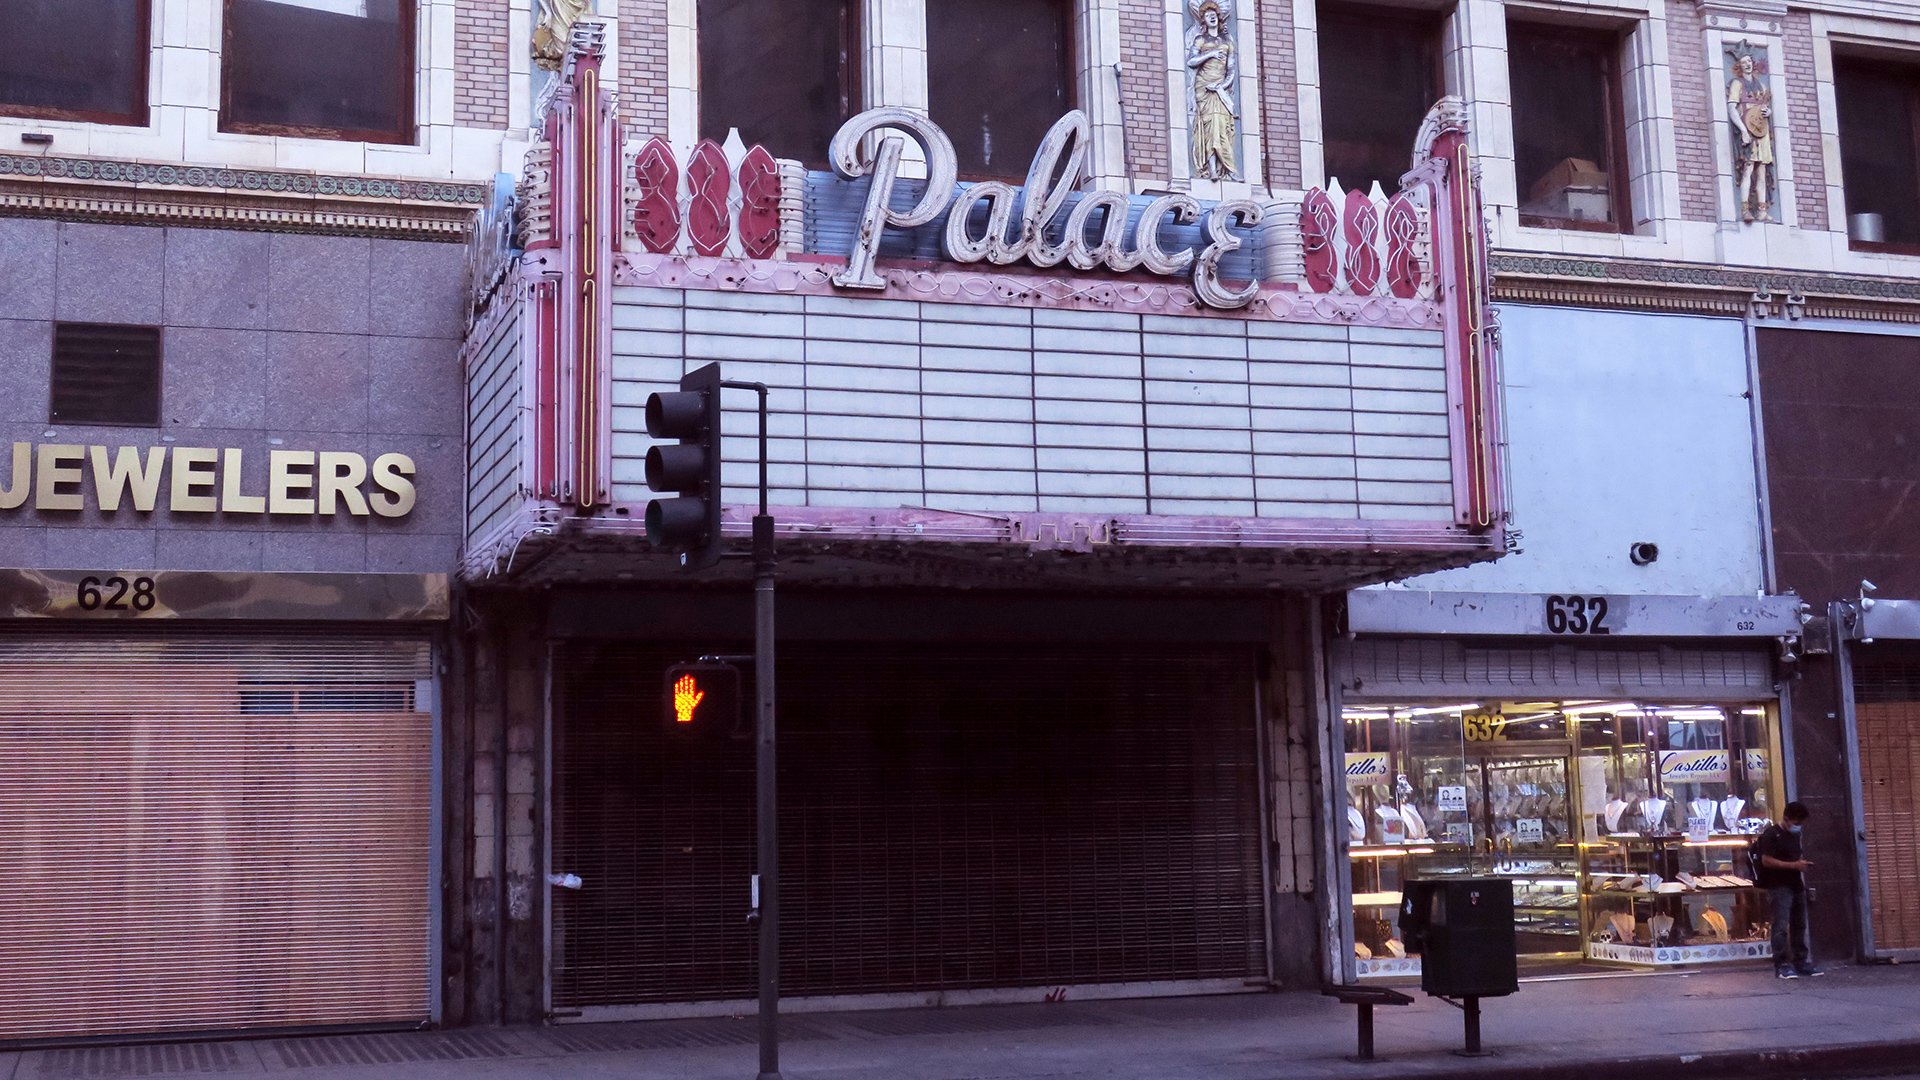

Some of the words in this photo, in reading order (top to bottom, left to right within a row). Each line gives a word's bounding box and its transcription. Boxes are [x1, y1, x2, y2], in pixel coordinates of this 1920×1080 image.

[829, 106, 1265, 309] Palace
[0, 442, 416, 518] JEWELERS
[77, 576, 155, 611] 628
[1546, 595, 1610, 635] 632
[1737, 621, 1755, 631] 632
[1463, 714, 1507, 742] 632
[1345, 757, 1387, 775] tillo's
[1660, 752, 1727, 775] Castillo's
